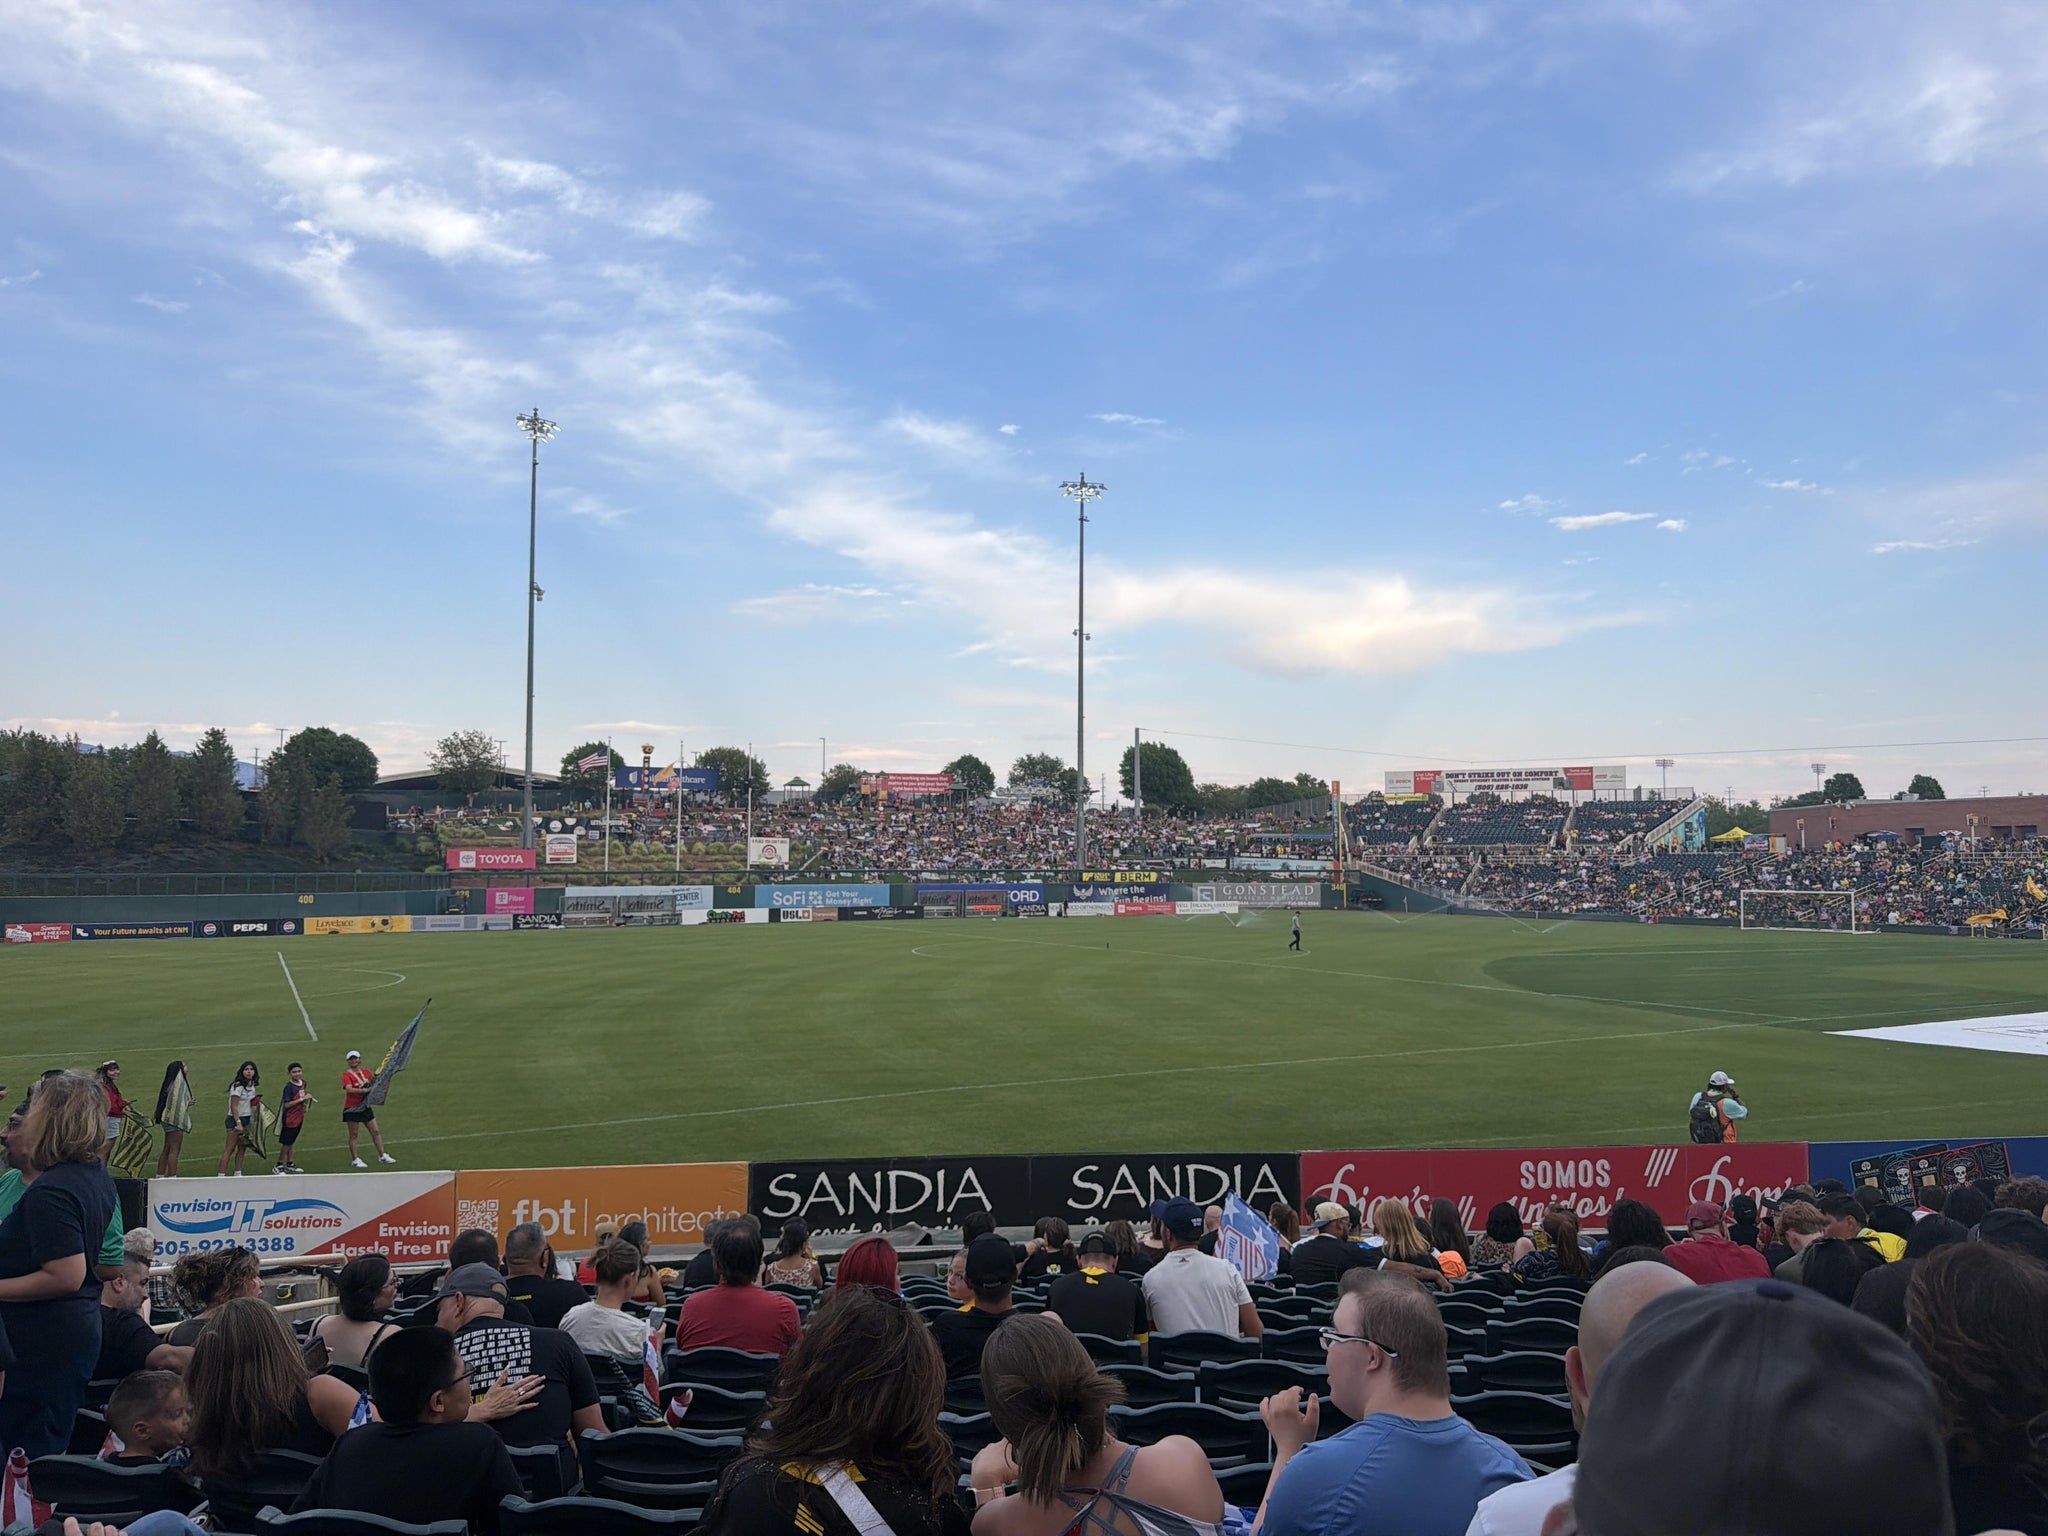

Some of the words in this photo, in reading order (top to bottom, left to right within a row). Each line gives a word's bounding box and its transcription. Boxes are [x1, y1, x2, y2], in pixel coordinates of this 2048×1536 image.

[479, 854, 524, 864] TOYOTA
[1120, 872, 1151, 880] BERM
[676, 892, 700, 902] CENTER
[728, 886, 741, 894] 404
[1099, 886, 1129, 896] Where
[1130, 885, 1145, 893] the
[298, 895, 314, 904] 400
[773, 891, 806, 906] SoFi
[826, 898, 851, 906] Money
[517, 915, 557, 923] SANDIA
[783, 910, 801, 919] USL
[233, 923, 267, 932] PEPSI
[1520, 1159, 1611, 1189] SOMOS
[762, 1167, 993, 1217] SANDIA
[1066, 1163, 1288, 1210] SANDIA
[160, 1199, 233, 1213] envision
[228, 1200, 276, 1232] IT
[264, 1216, 342, 1230] solutions
[512, 1199, 576, 1236] fbt
[379, 1221, 450, 1237] Envision
[155, 1237, 295, 1256] 505-923-3388
[332, 1241, 389, 1257] Hassle
[394, 1241, 431, 1255] Free
[436, 1240, 450, 1254] IT
